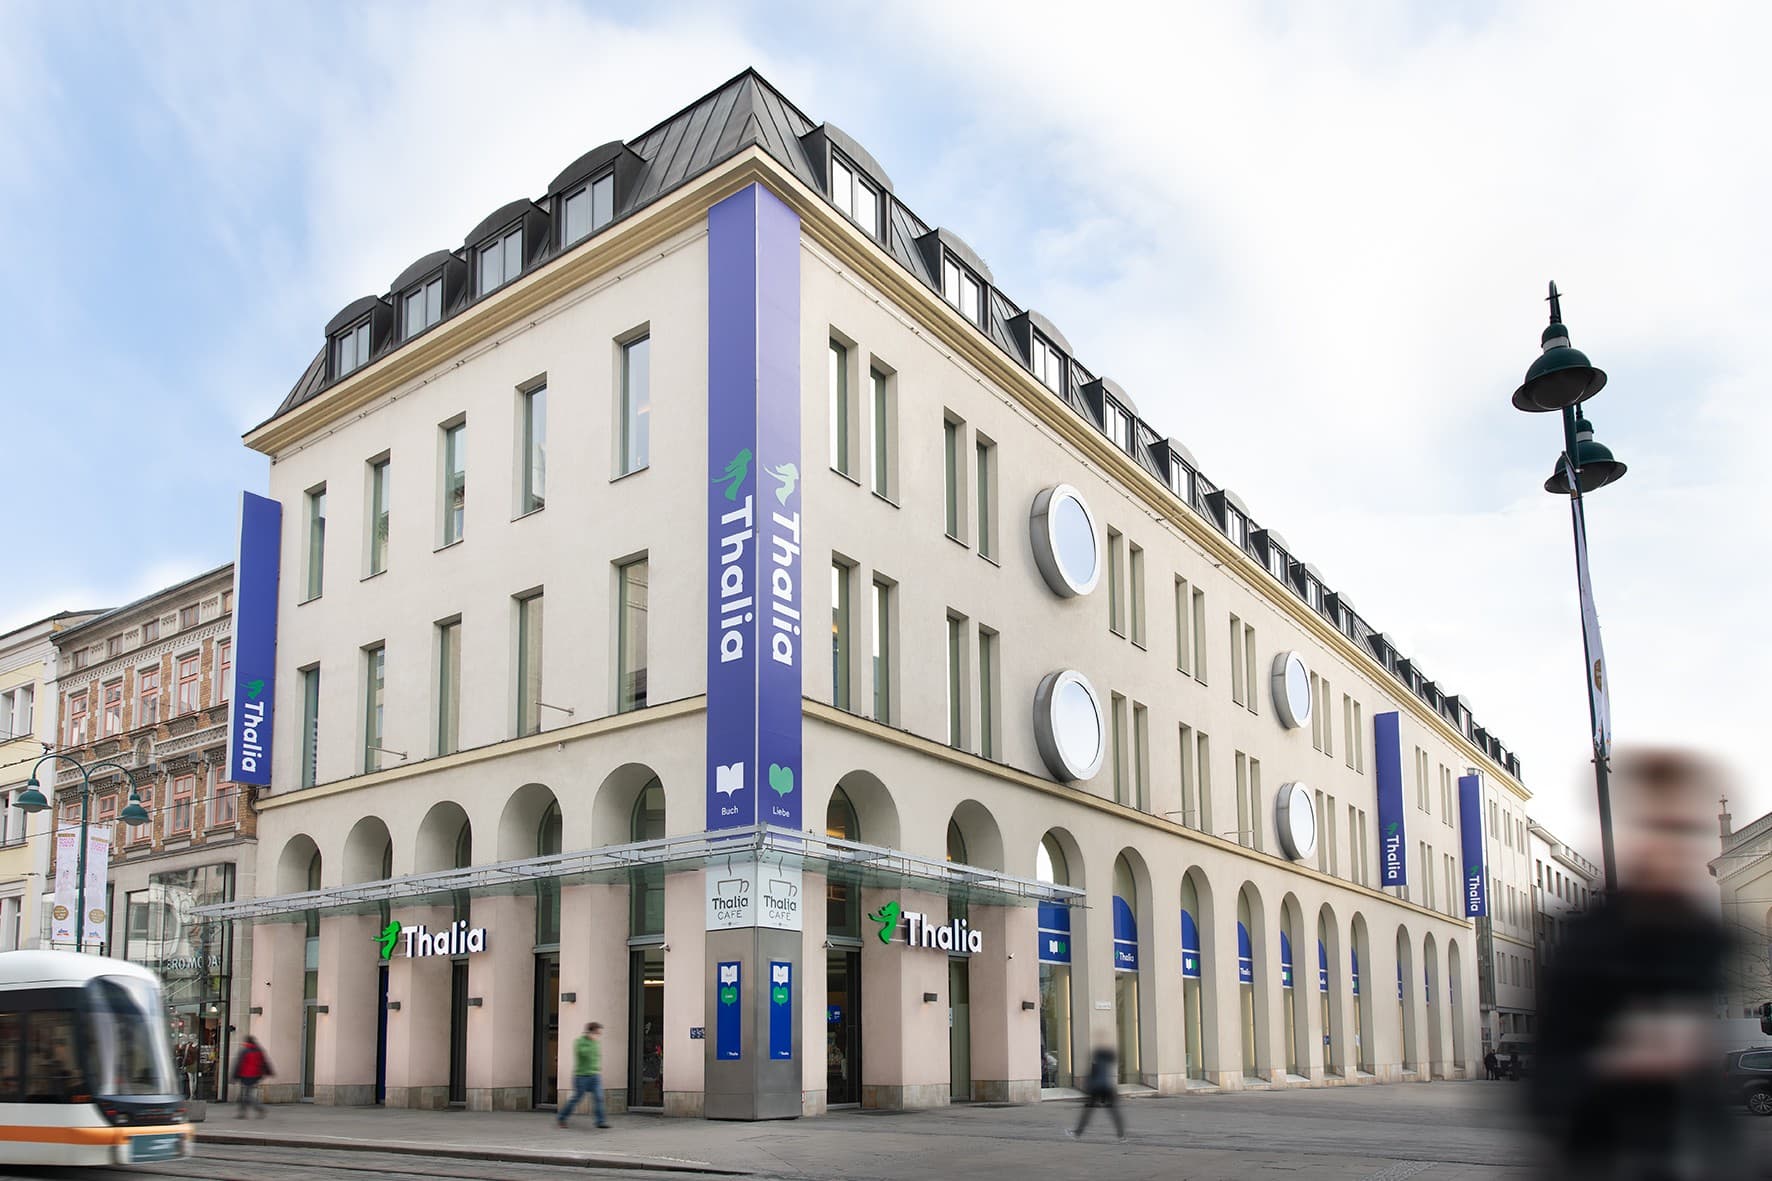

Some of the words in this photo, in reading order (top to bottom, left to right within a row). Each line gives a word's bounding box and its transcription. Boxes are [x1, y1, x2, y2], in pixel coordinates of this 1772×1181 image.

[721, 494, 752, 663] Thalia
[772, 511, 800, 666] Thalia
[241, 701, 265, 773] Thalia
[721, 806, 739, 816] Buch
[772, 806, 790, 817] Liebe
[1386, 834, 1401, 879] Thalia
[711, 896, 749, 910] Thalia
[763, 895, 797, 912] Thalia
[1469, 875, 1481, 912] Thalia
[401, 919, 487, 958] Thalia
[901, 910, 982, 953] Thalia
